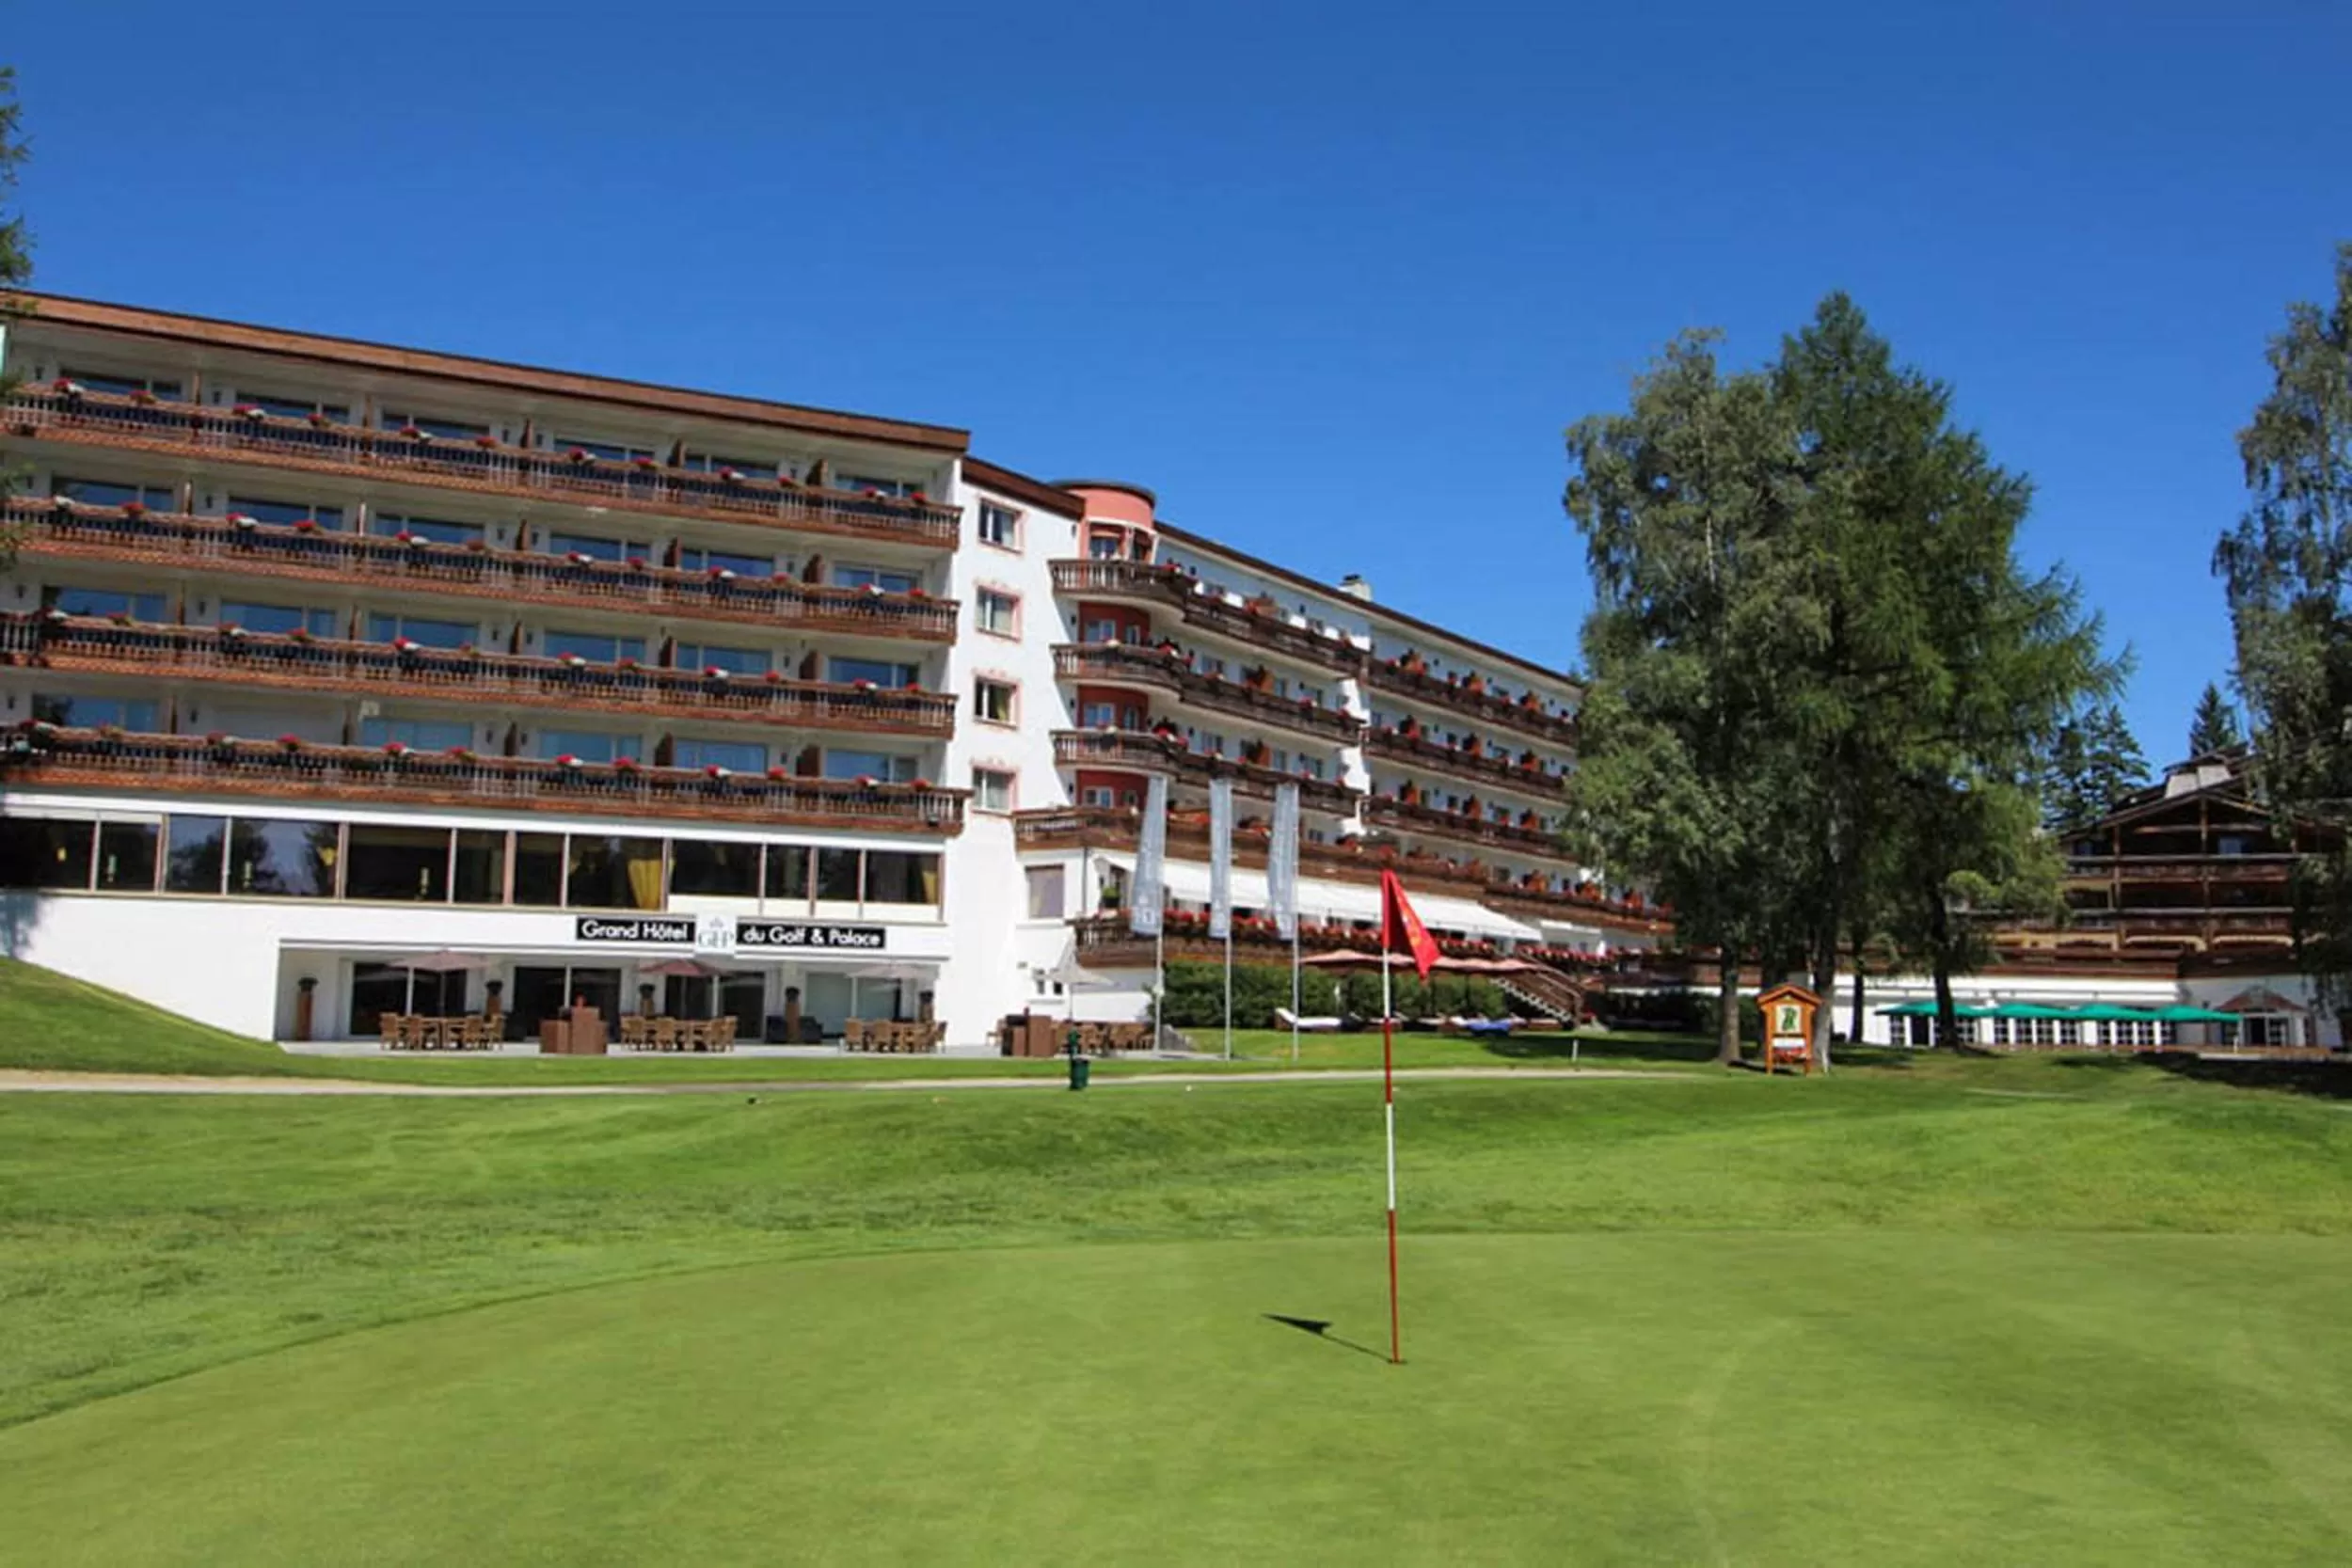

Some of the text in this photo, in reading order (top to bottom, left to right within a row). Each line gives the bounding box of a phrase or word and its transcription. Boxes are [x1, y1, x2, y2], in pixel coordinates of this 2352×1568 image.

[581, 920, 639, 939] Grand
[743, 926, 882, 946] du Golf & Palace
